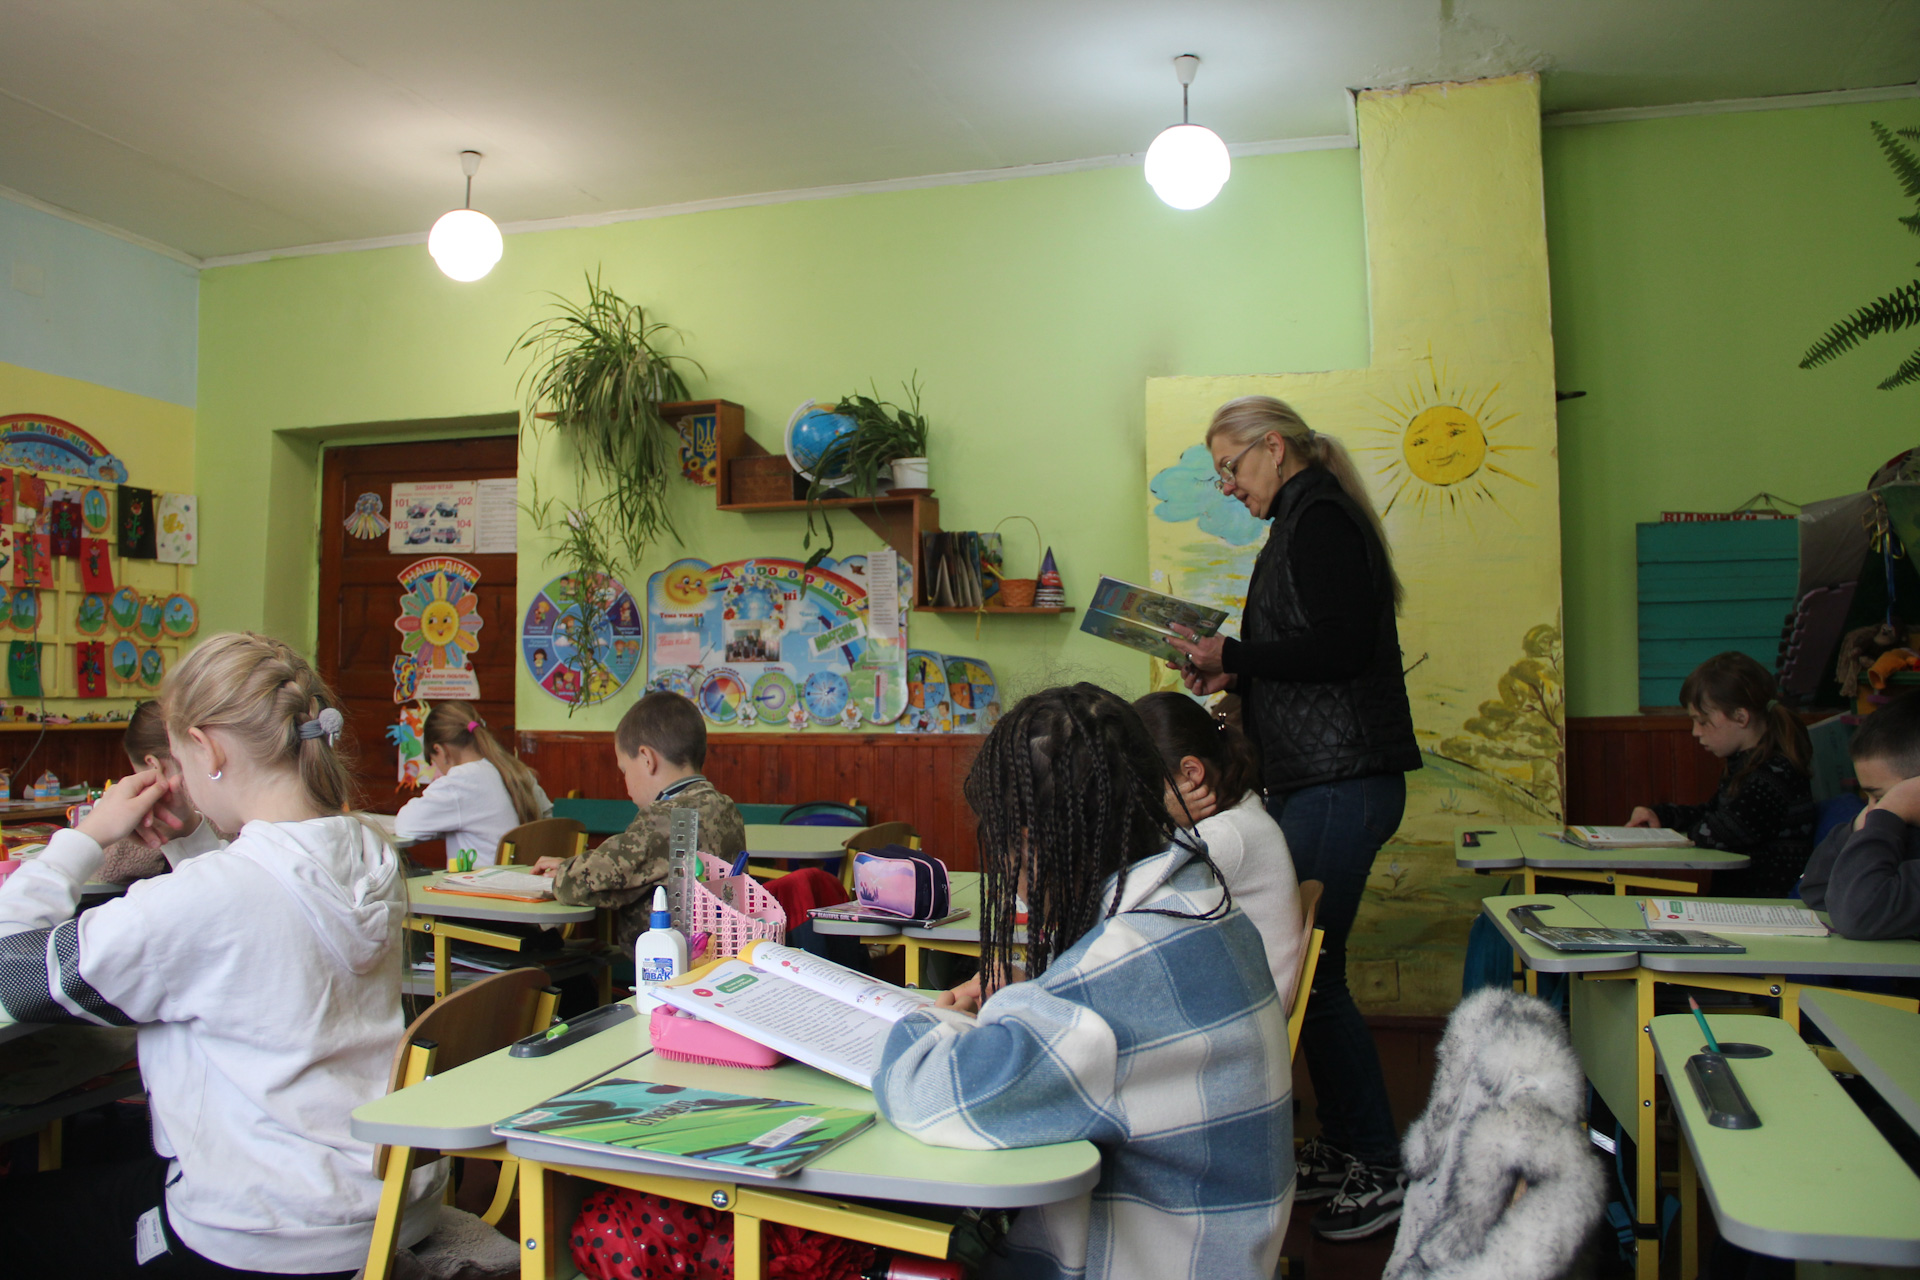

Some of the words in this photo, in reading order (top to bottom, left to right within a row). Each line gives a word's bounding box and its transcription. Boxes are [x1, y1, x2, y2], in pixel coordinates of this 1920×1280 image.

[395, 499, 409, 507] 101
[458, 497, 473, 506] 102
[394, 521, 409, 530] 103
[457, 519, 472, 528] 104
[406, 560, 439, 583] НАШІ
[720, 559, 798, 582] Доброго
[804, 573, 856, 606] ранку
